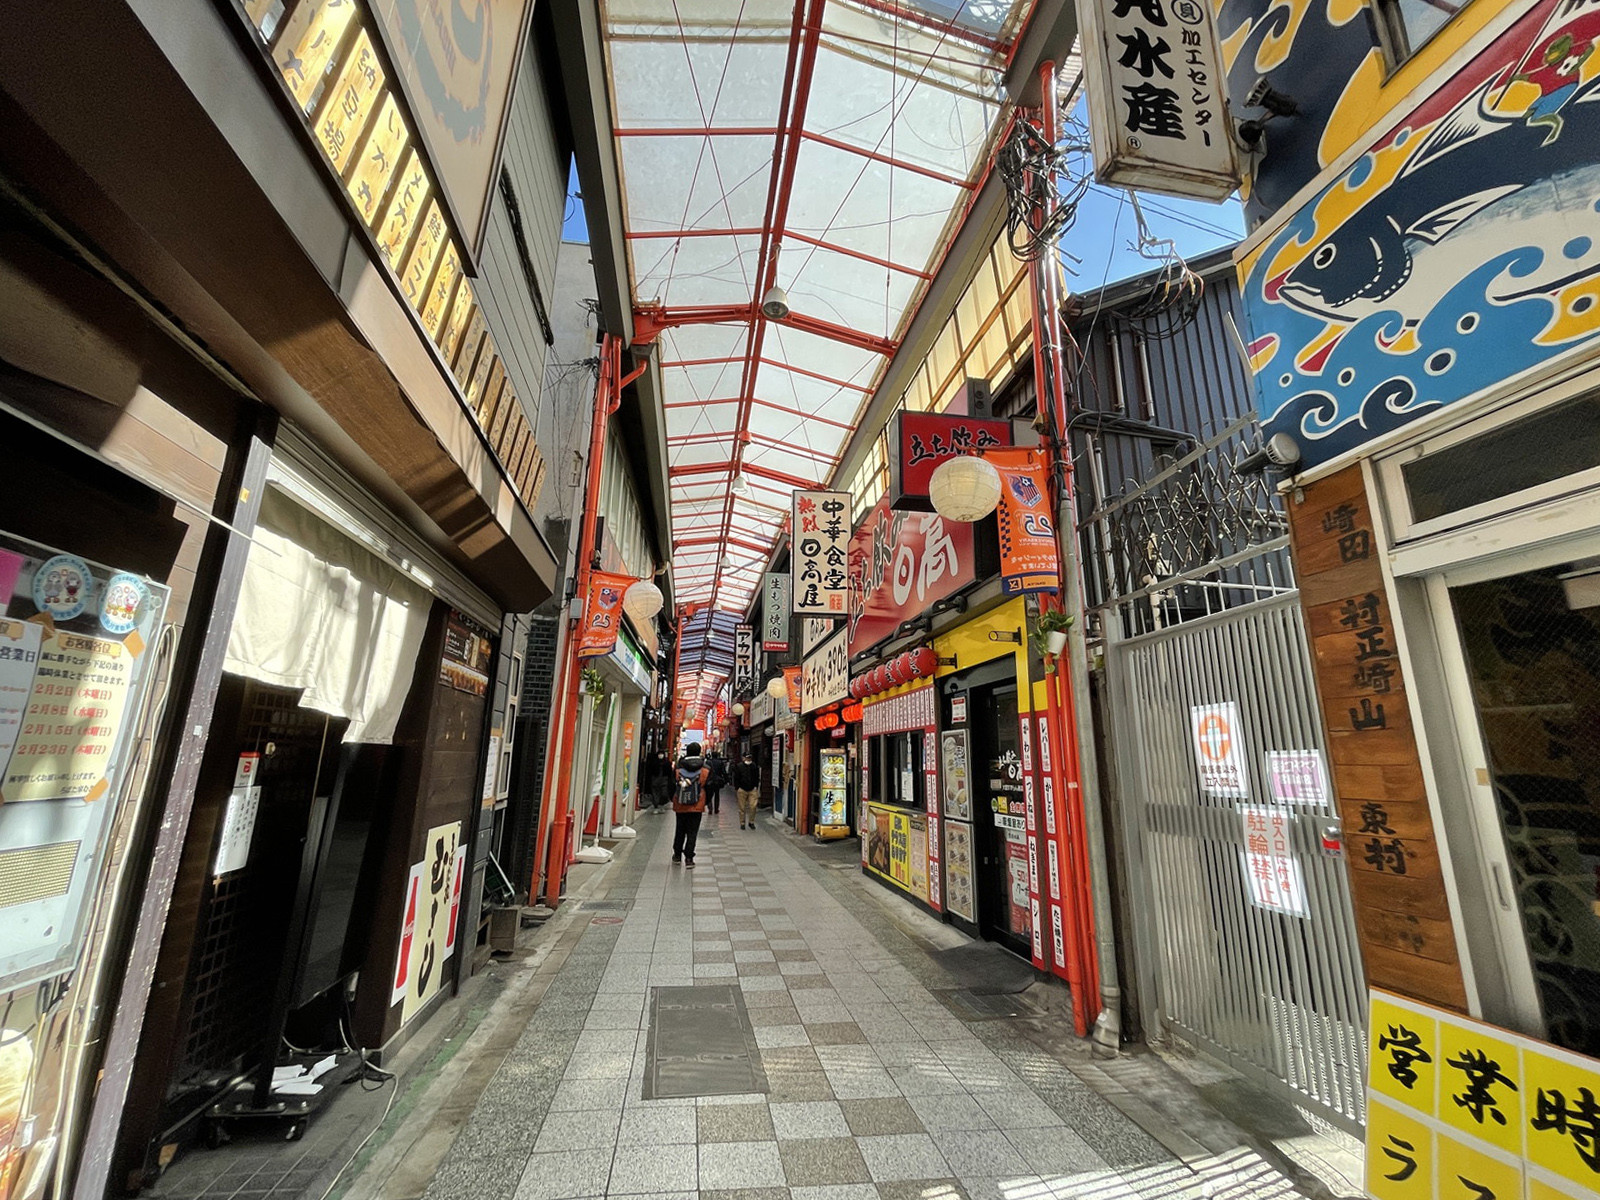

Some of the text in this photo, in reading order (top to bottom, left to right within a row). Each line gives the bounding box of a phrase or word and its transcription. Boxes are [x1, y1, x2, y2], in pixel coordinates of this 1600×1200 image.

[1181, 27, 1212, 147] 加工センター
[821, 498, 847, 590] 中華食堂
[769, 578, 781, 639] 生もつ焼肉
[1247, 810, 1279, 906] 駐輪禁止
